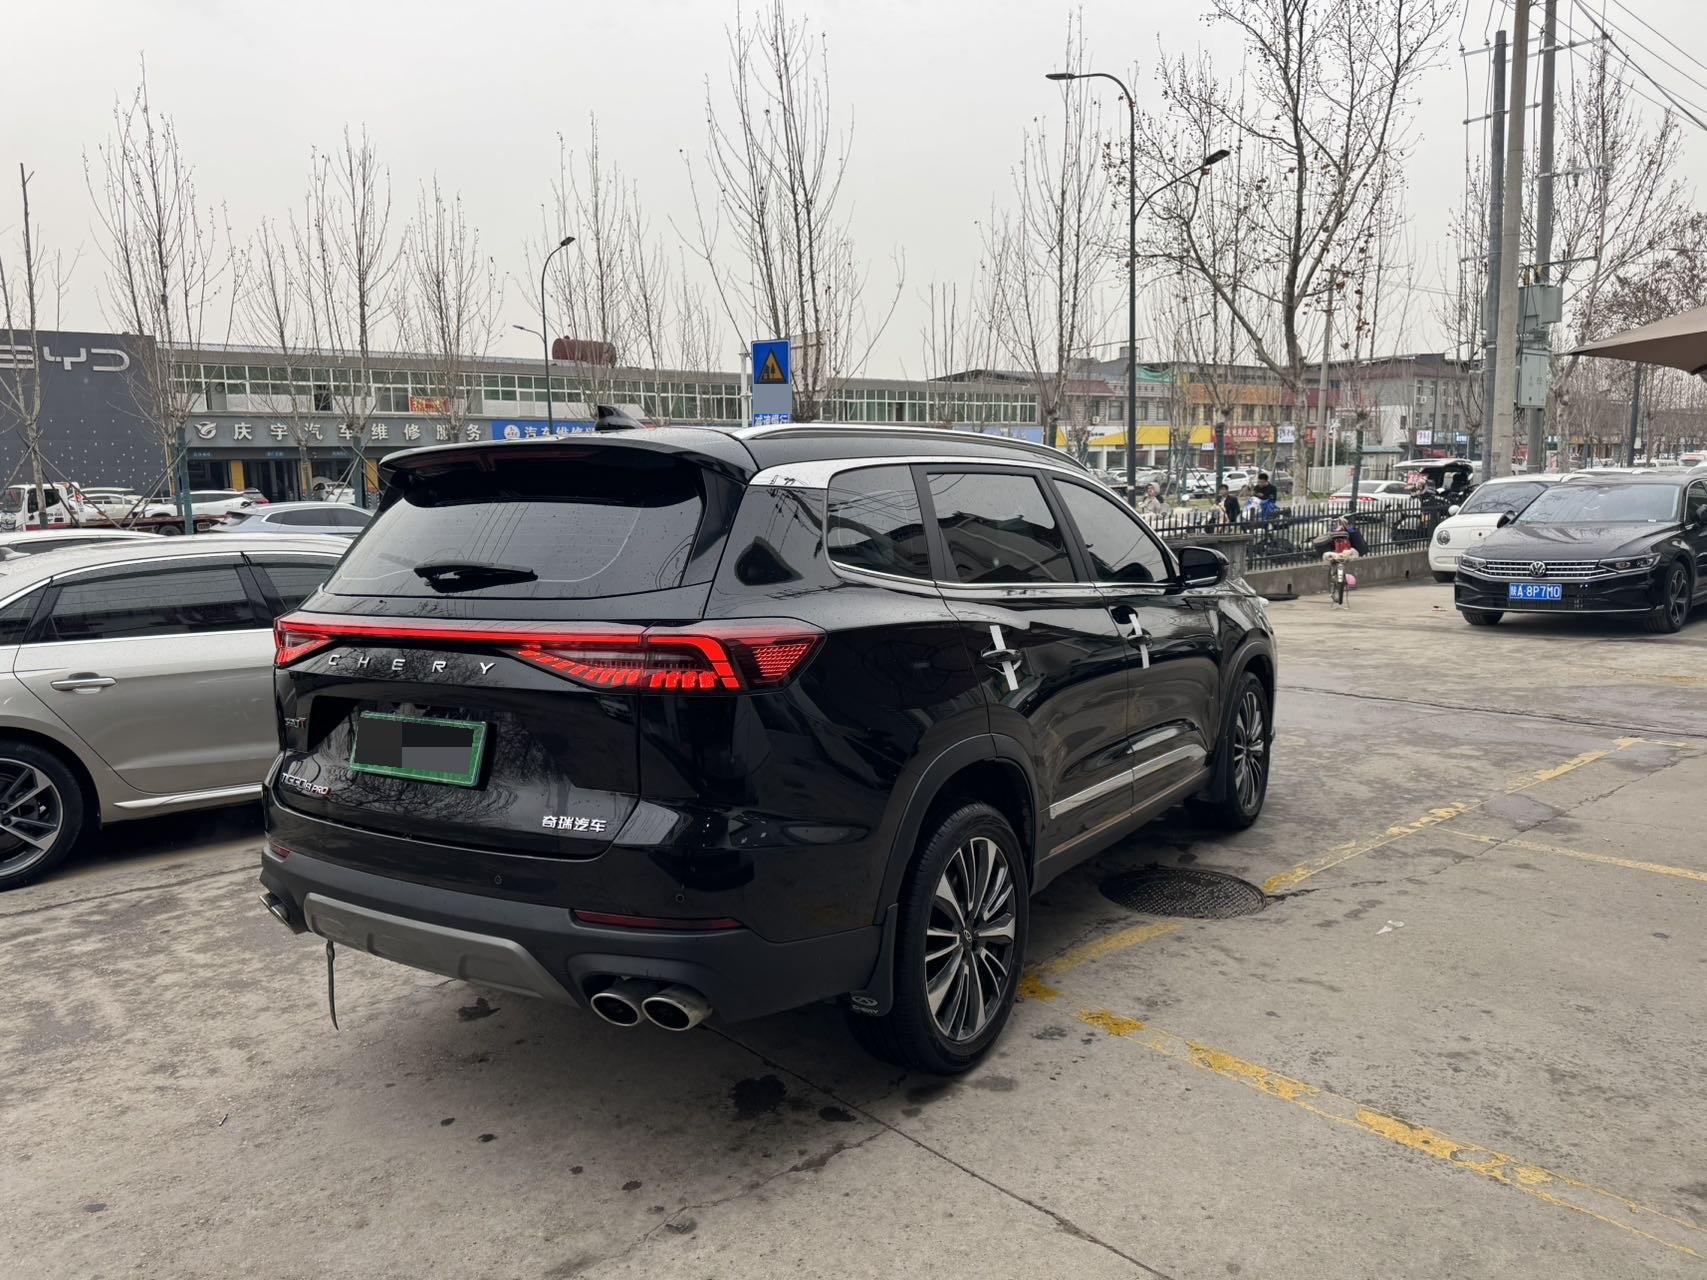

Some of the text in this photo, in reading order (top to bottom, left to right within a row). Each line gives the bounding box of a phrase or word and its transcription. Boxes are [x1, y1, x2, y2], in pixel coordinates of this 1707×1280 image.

[0, 345, 130, 371] BYD
[233, 423, 482, 441] 庆宇汽车维修服务
[328, 654, 495, 675] CHERY
[542, 816, 607, 833] 奇瑞汽车
